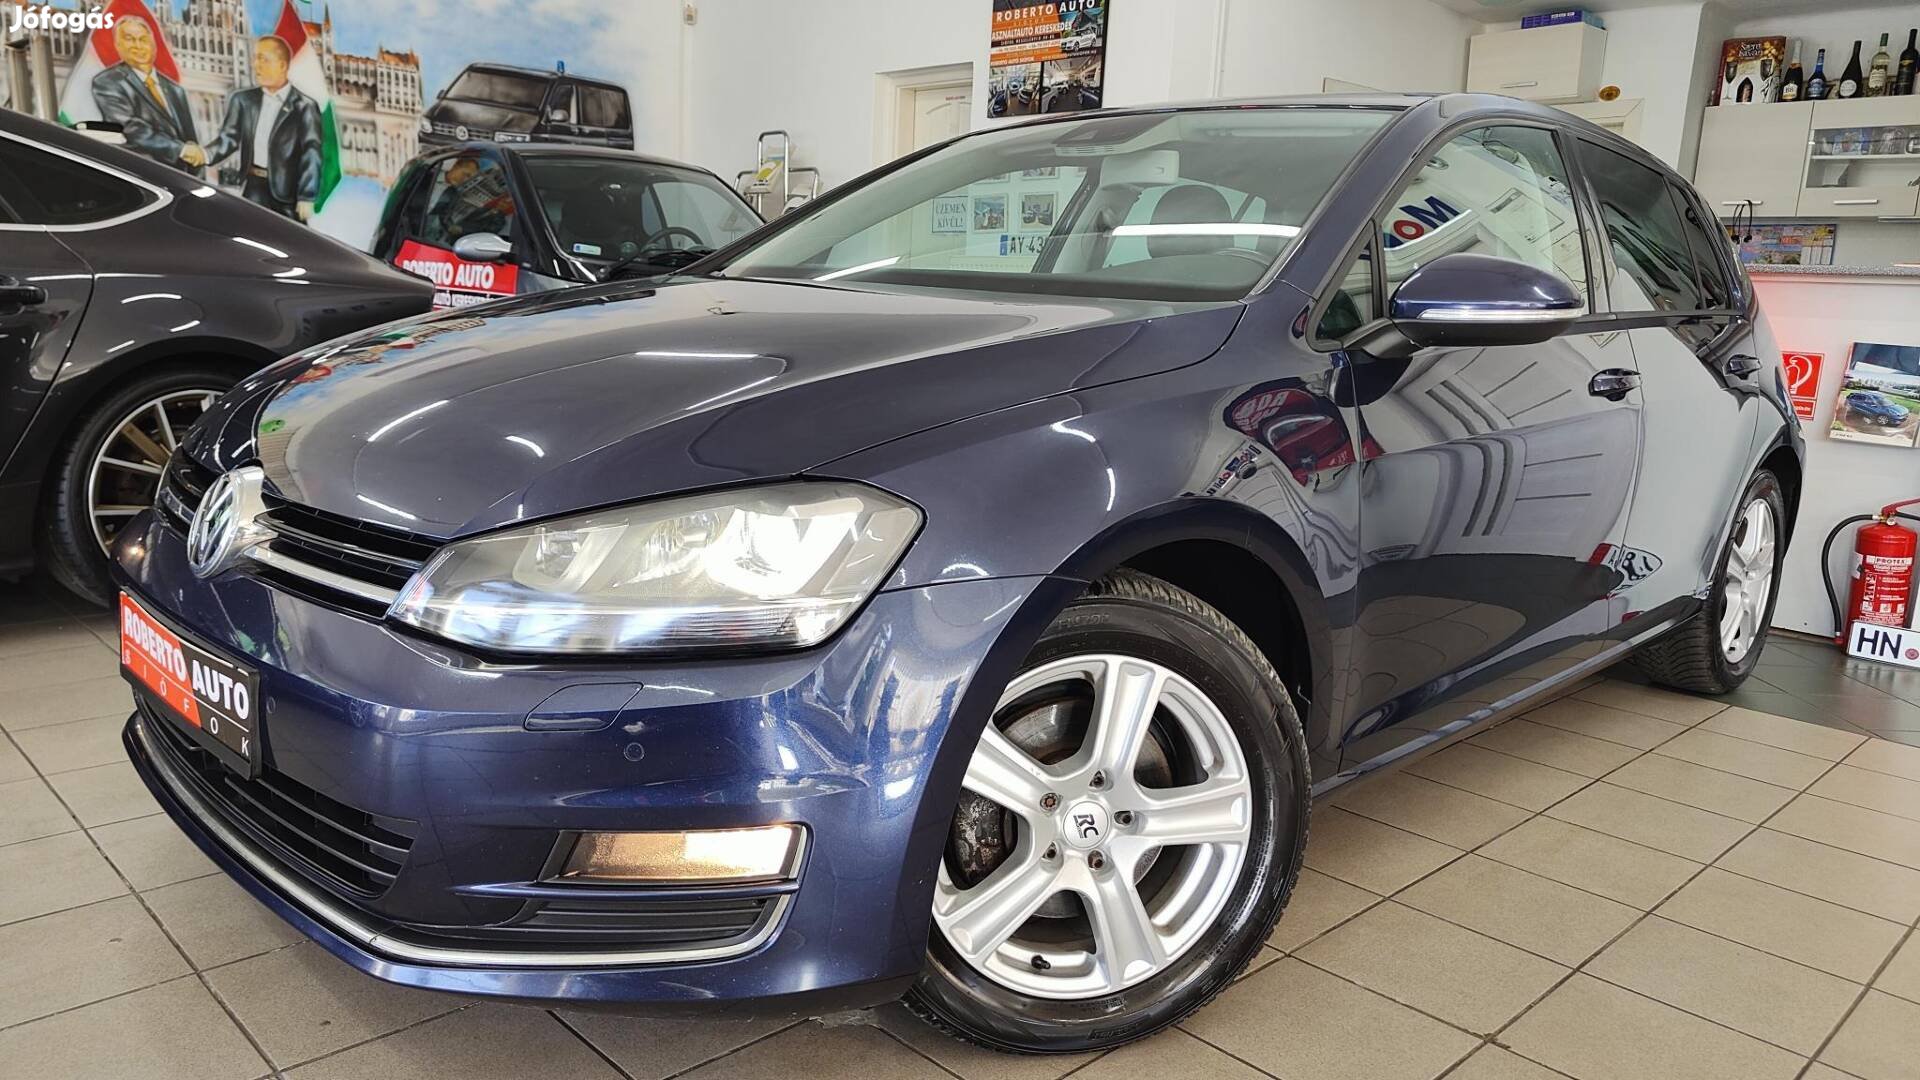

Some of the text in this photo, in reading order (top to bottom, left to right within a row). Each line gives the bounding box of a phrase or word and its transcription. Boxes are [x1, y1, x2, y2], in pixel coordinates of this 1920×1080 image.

[996, 0, 1096, 22] ROBERTO AUTO
[454, 263, 495, 289] AUTO
[1857, 628, 1902, 659] HN
[124, 605, 250, 721] ROBERTO AUTO
[1078, 814, 1099, 838] RC
